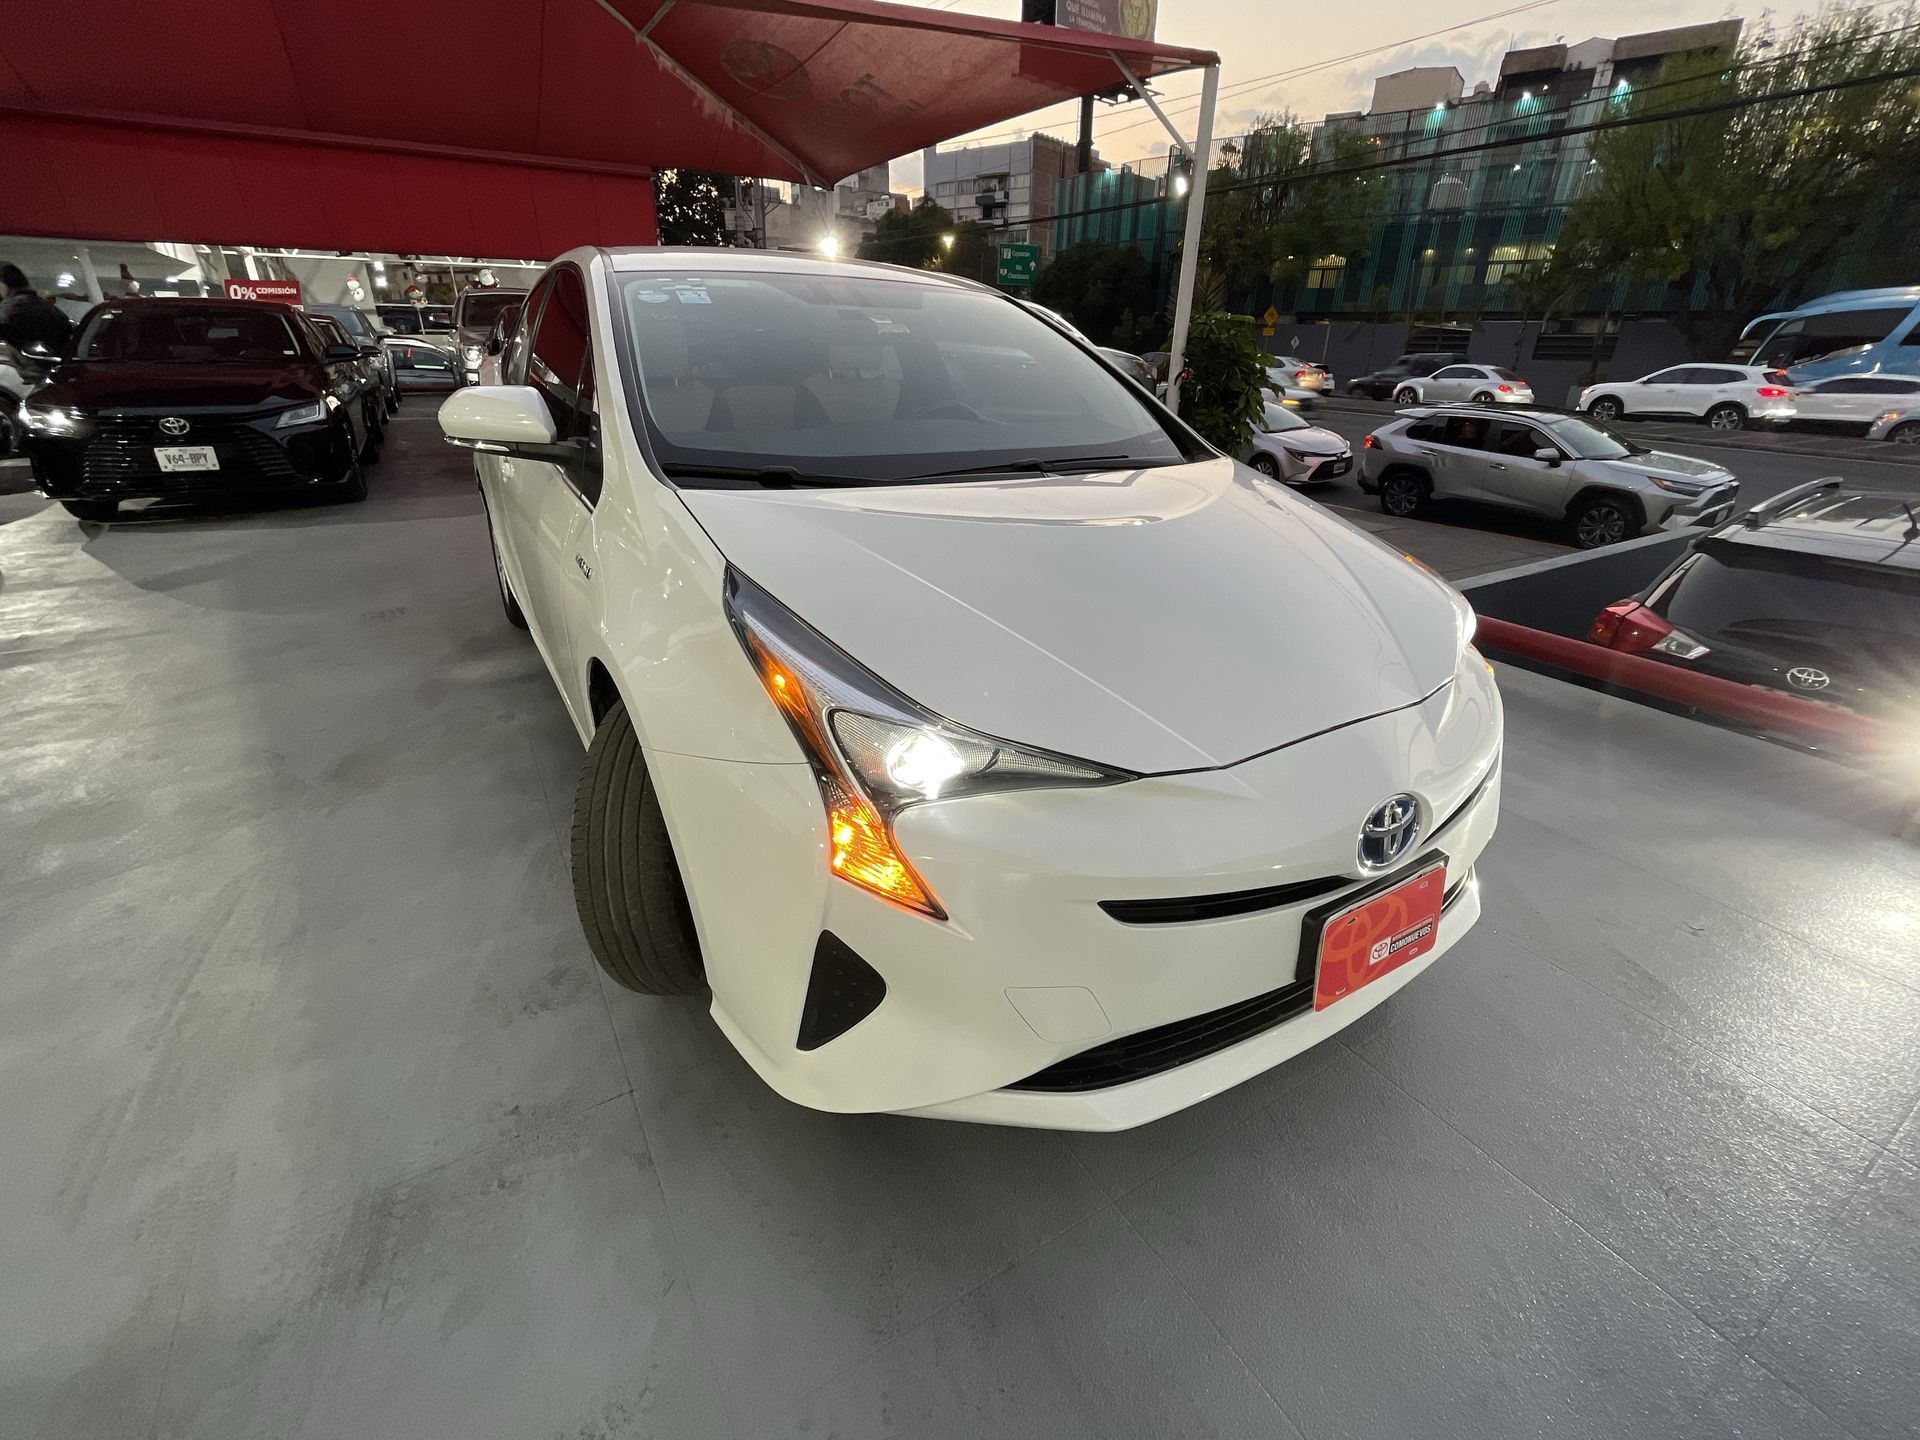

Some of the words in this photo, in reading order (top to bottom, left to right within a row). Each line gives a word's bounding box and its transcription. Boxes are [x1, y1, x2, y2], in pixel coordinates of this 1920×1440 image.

[1066, 1, 1080, 14] QUE
[1081, 6, 1107, 24] ILUMINA
[229, 284, 257, 300] 0%
[256, 286, 297, 295] COMISIÓN
[1390, 924, 1432, 953] COMONUEVOS
